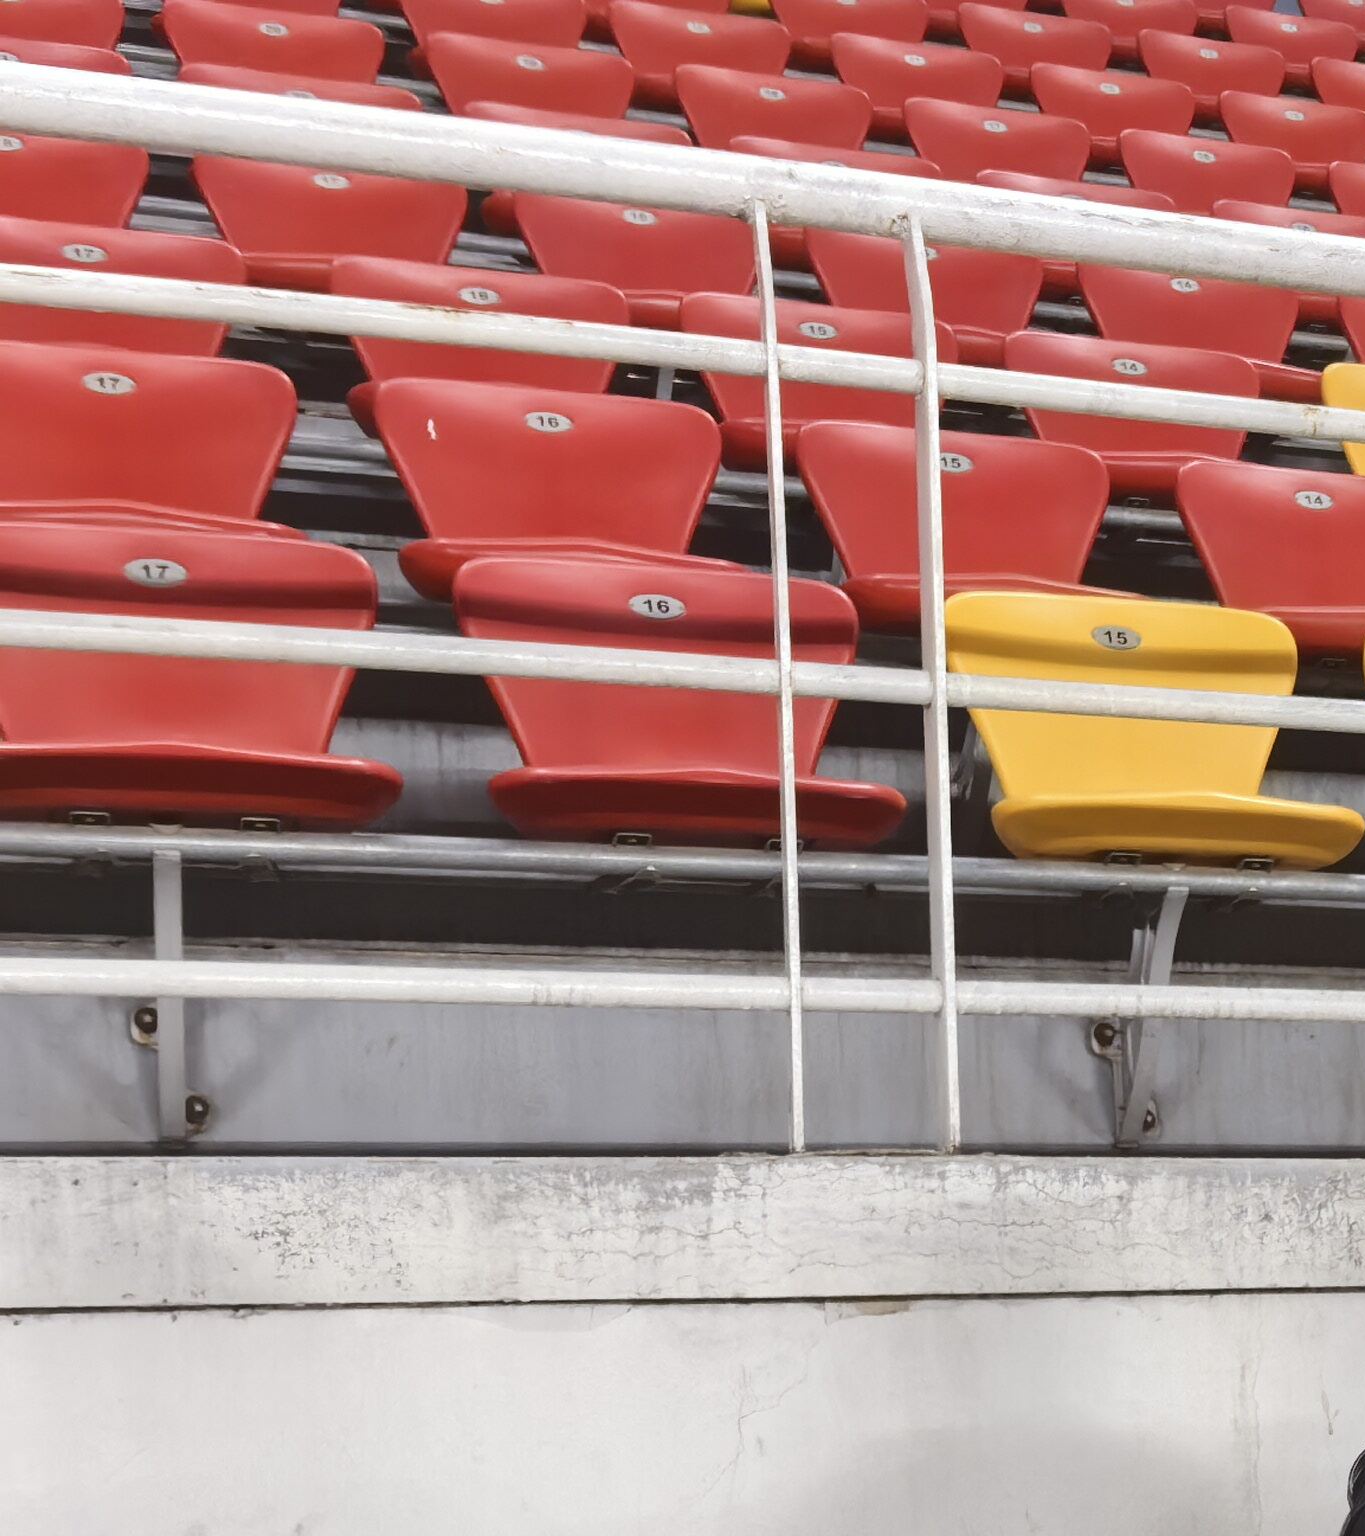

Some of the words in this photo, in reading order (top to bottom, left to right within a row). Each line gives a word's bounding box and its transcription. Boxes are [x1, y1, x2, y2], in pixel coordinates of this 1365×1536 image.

[808, 325, 828, 336] 15
[1119, 361, 1138, 372] 14
[97, 377, 120, 391] 17
[536, 415, 559, 428] 16
[940, 457, 961, 469] 15
[1304, 495, 1323, 506] 14
[142, 564, 170, 579] 17
[642, 599, 670, 614] 16
[1103, 630, 1128, 645] 15
